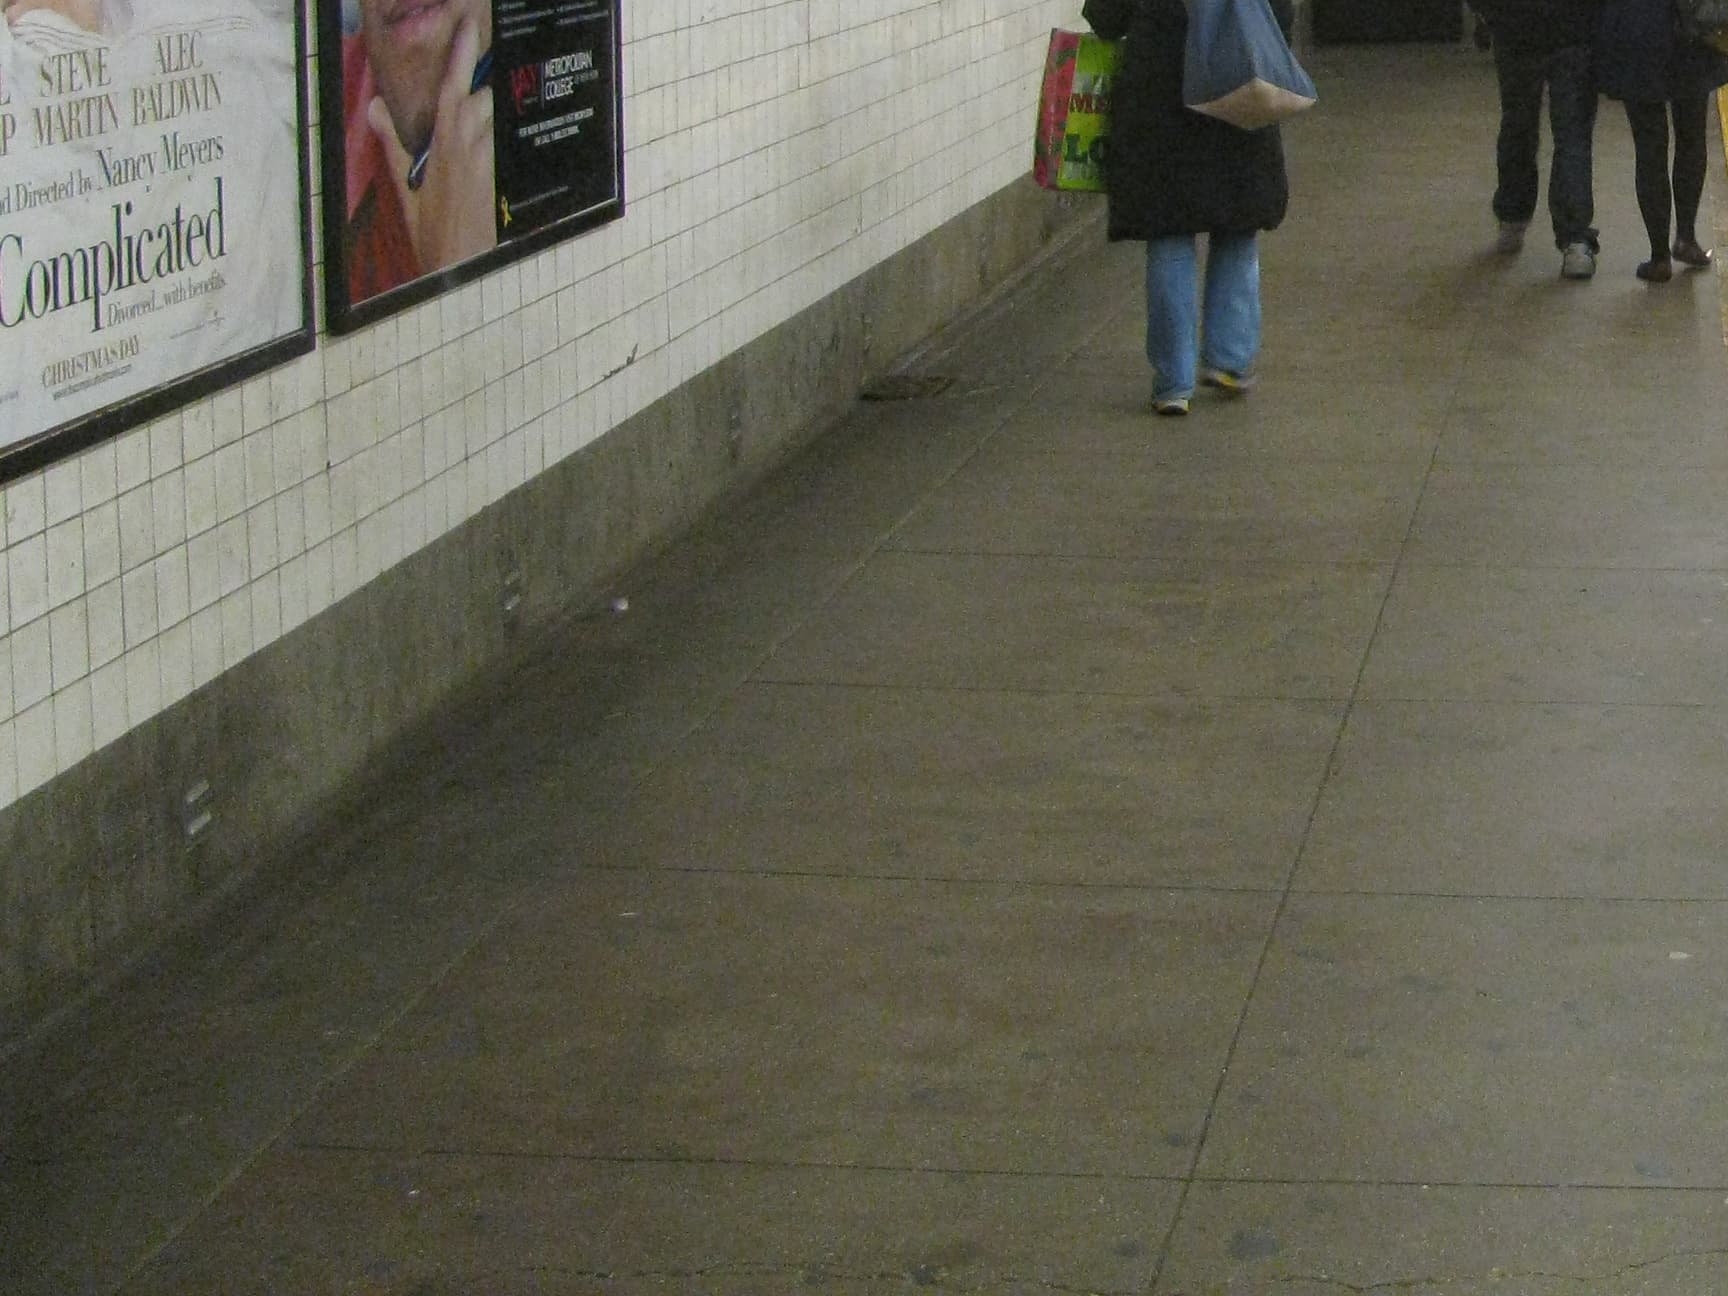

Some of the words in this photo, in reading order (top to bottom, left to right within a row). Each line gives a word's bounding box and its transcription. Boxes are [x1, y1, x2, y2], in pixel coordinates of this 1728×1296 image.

[40, 46, 112, 98] STEVE
[152, 30, 203, 76] ALEC
[32, 91, 119, 149] MARTIN
[133, 70, 222, 127] BALDWIN
[15, 171, 74, 211] Directed
[95, 146, 157, 193] Nancy
[160, 131, 224, 182] Meyers
[0, 176, 227, 333] Complicated
[42, 347, 118, 389] CHRISTMAS
[119, 334, 140, 360] DAY
